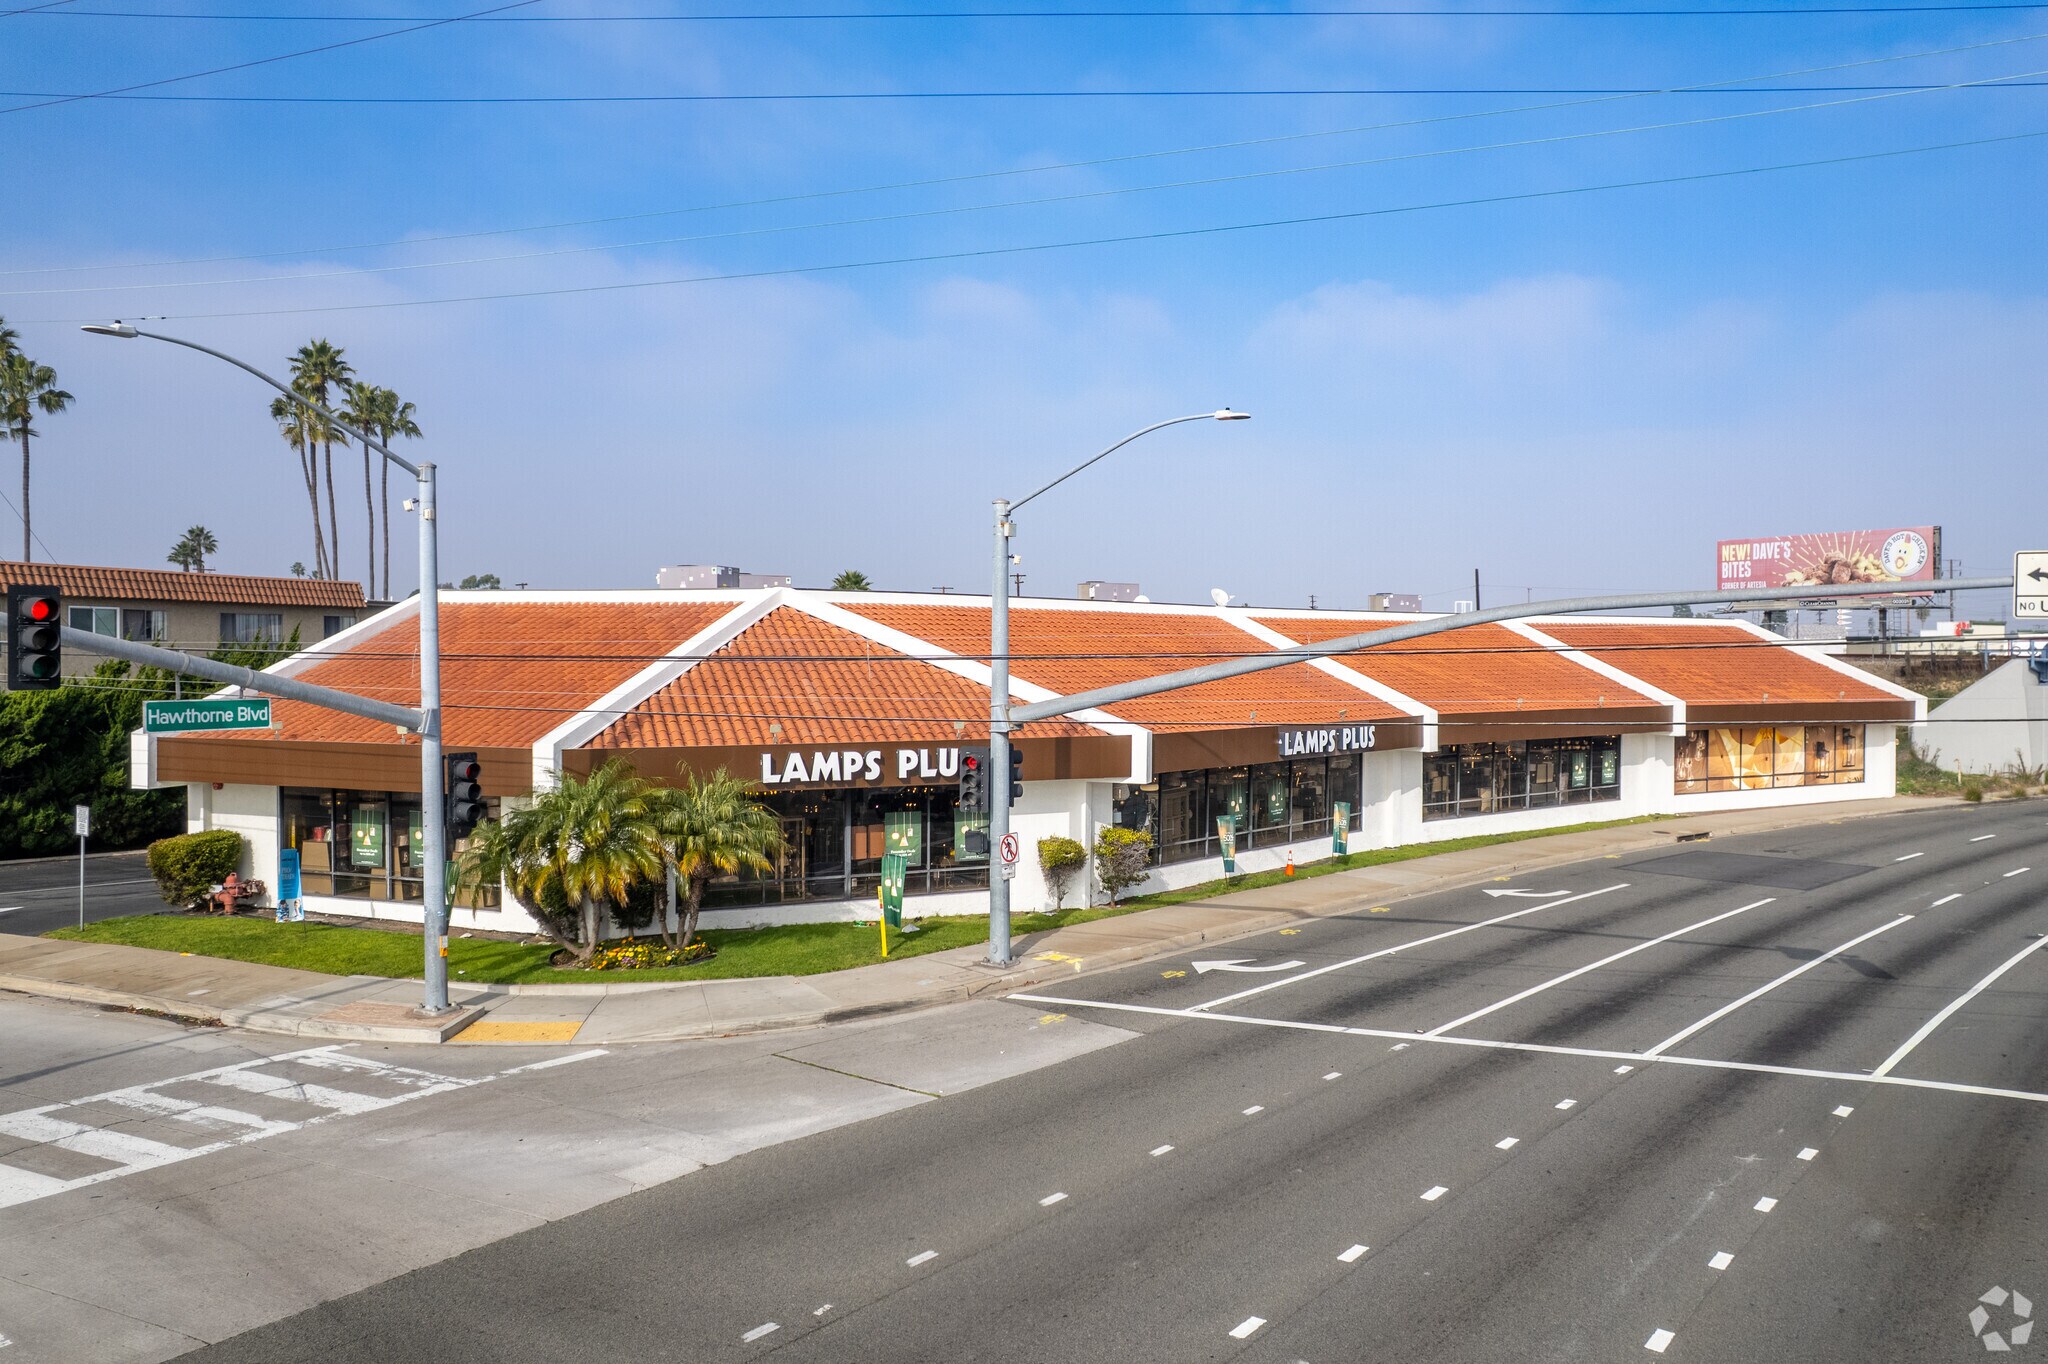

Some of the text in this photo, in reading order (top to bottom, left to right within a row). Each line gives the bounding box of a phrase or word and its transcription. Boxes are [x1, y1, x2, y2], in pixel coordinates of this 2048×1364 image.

[1892, 533, 1905, 543] HOT
[1721, 541, 1791, 562] NEW! DAVE'S
[1721, 561, 1752, 579] BITES
[1721, 582, 1739, 590] CORNER
[1747, 580, 1767, 589] ARTESIA
[2019, 602, 2036, 611] NO
[148, 706, 268, 725] Hawthorne Blvd
[1284, 725, 1376, 756] LAMPS PLUS
[761, 747, 960, 784] LAMPS PLU
